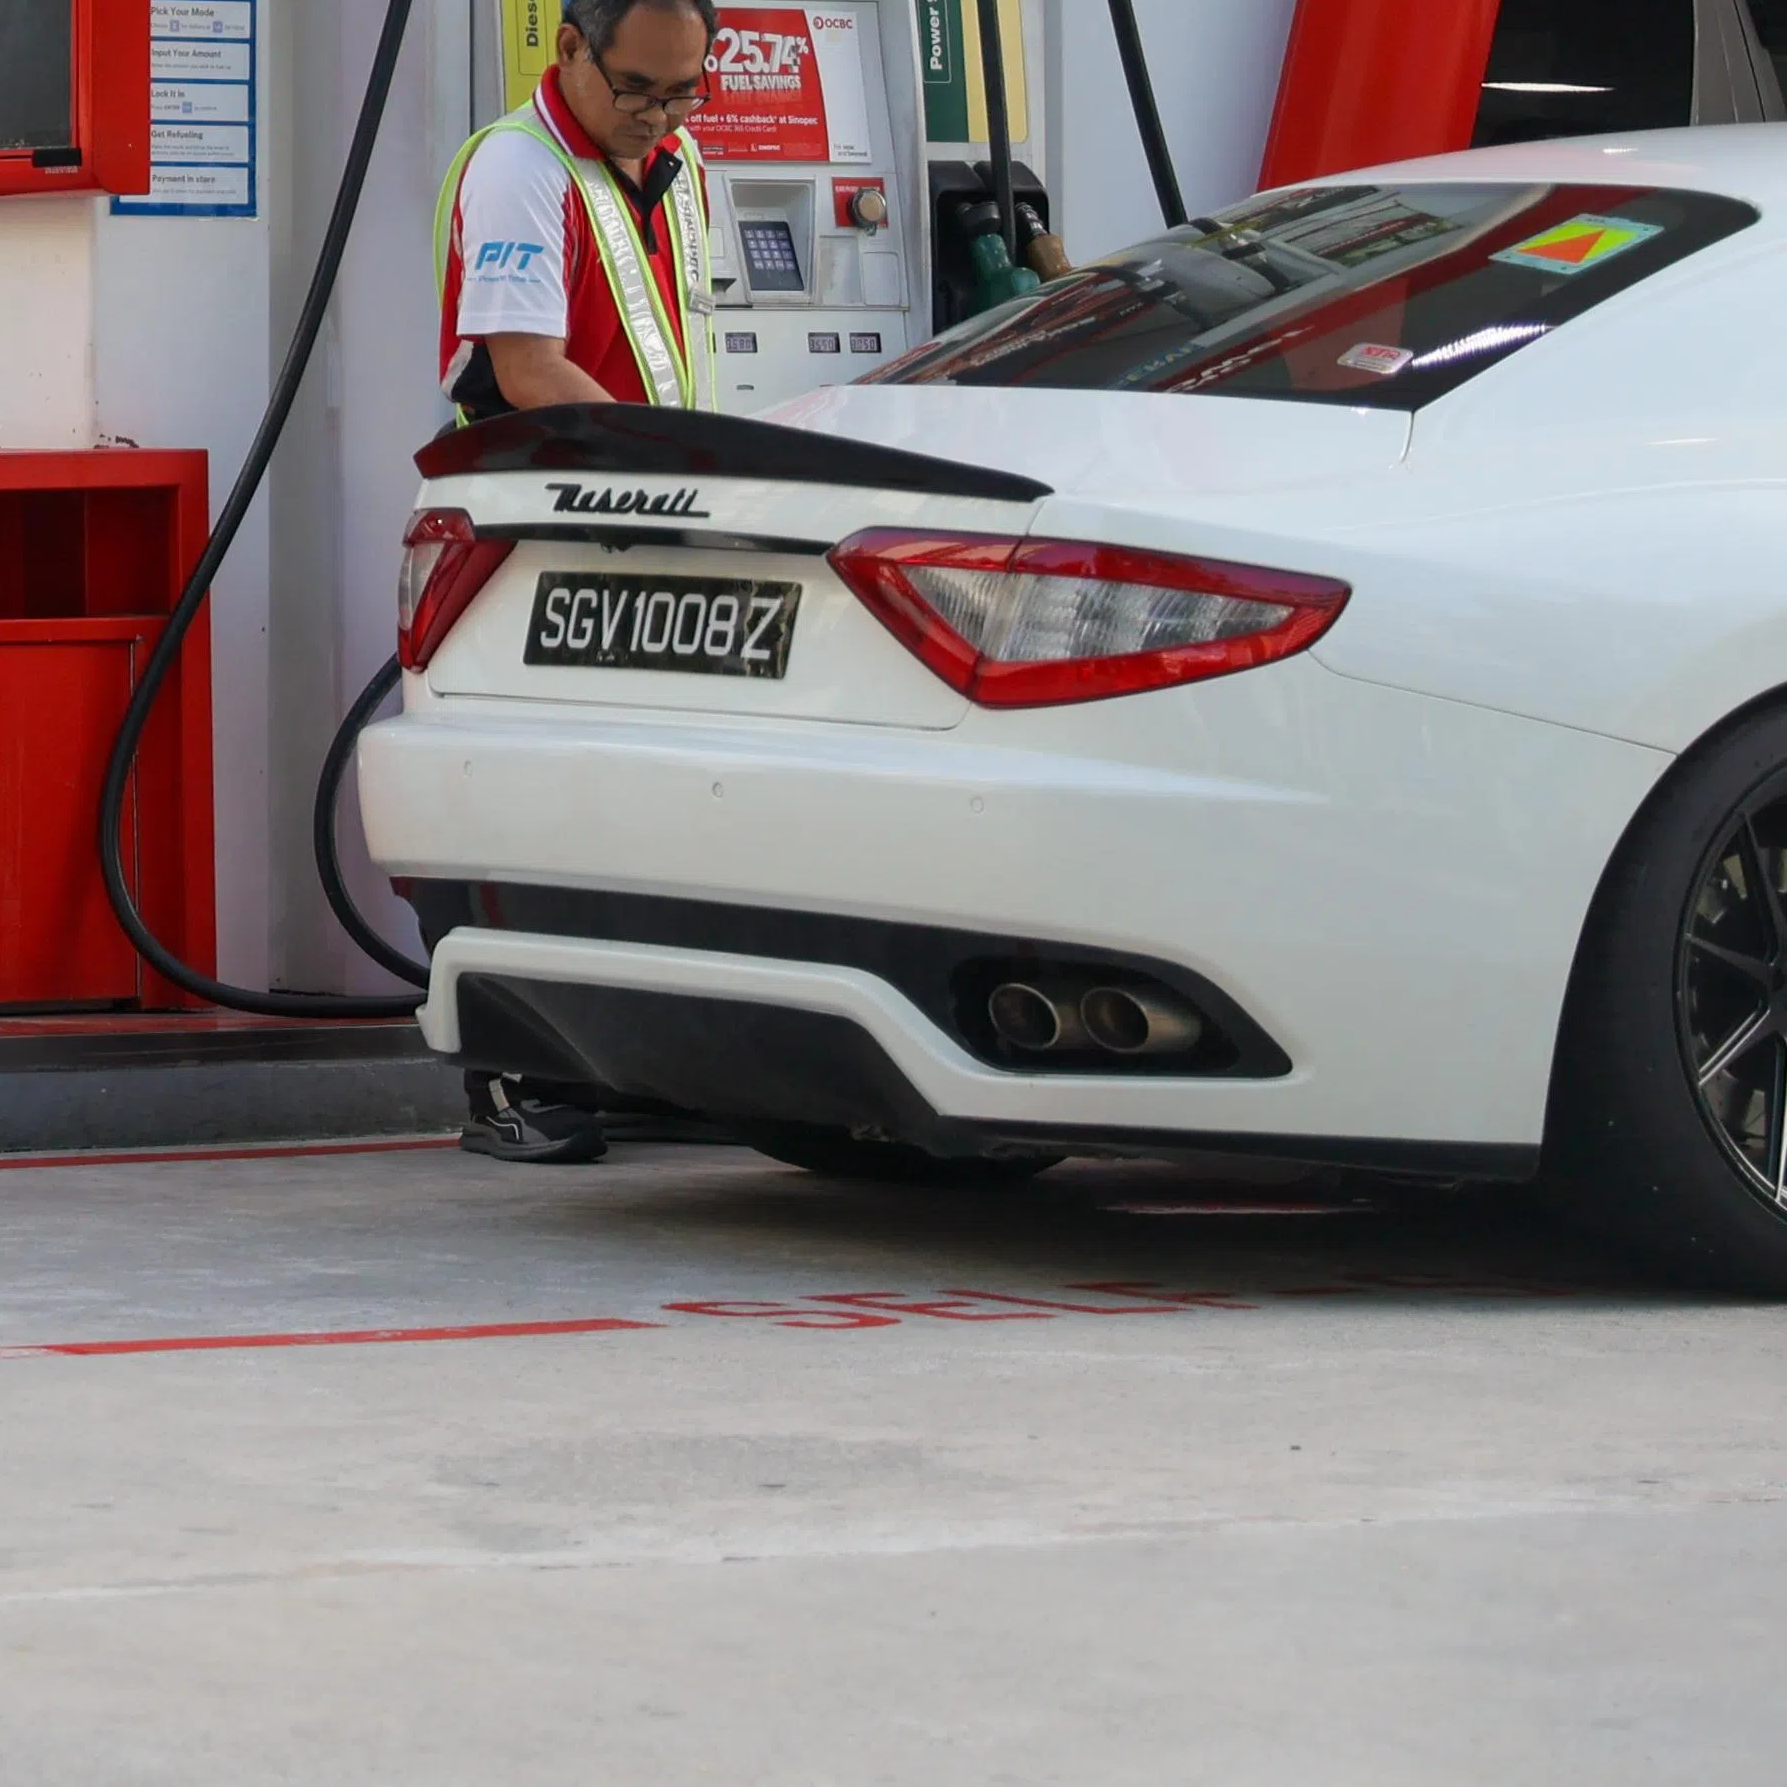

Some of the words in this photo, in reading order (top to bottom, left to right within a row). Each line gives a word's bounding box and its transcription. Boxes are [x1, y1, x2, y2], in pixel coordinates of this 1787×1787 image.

[171, 7, 189, 16] Your
[192, 8, 214, 17] Mode
[825, 17, 853, 29] OCBC
[929, 7, 943, 70] Power
[173, 50, 190, 58] Your
[192, 50, 221, 58] Amount
[721, 75, 754, 91] FUEL
[754, 76, 801, 92] SAVINGS
[167, 131, 203, 140] Refueling
[152, 175, 185, 184] Payment
[475, 242, 544, 271] PIT
[545, 483, 710, 518] Maserati
[540, 588, 783, 660] SGV1008Z
